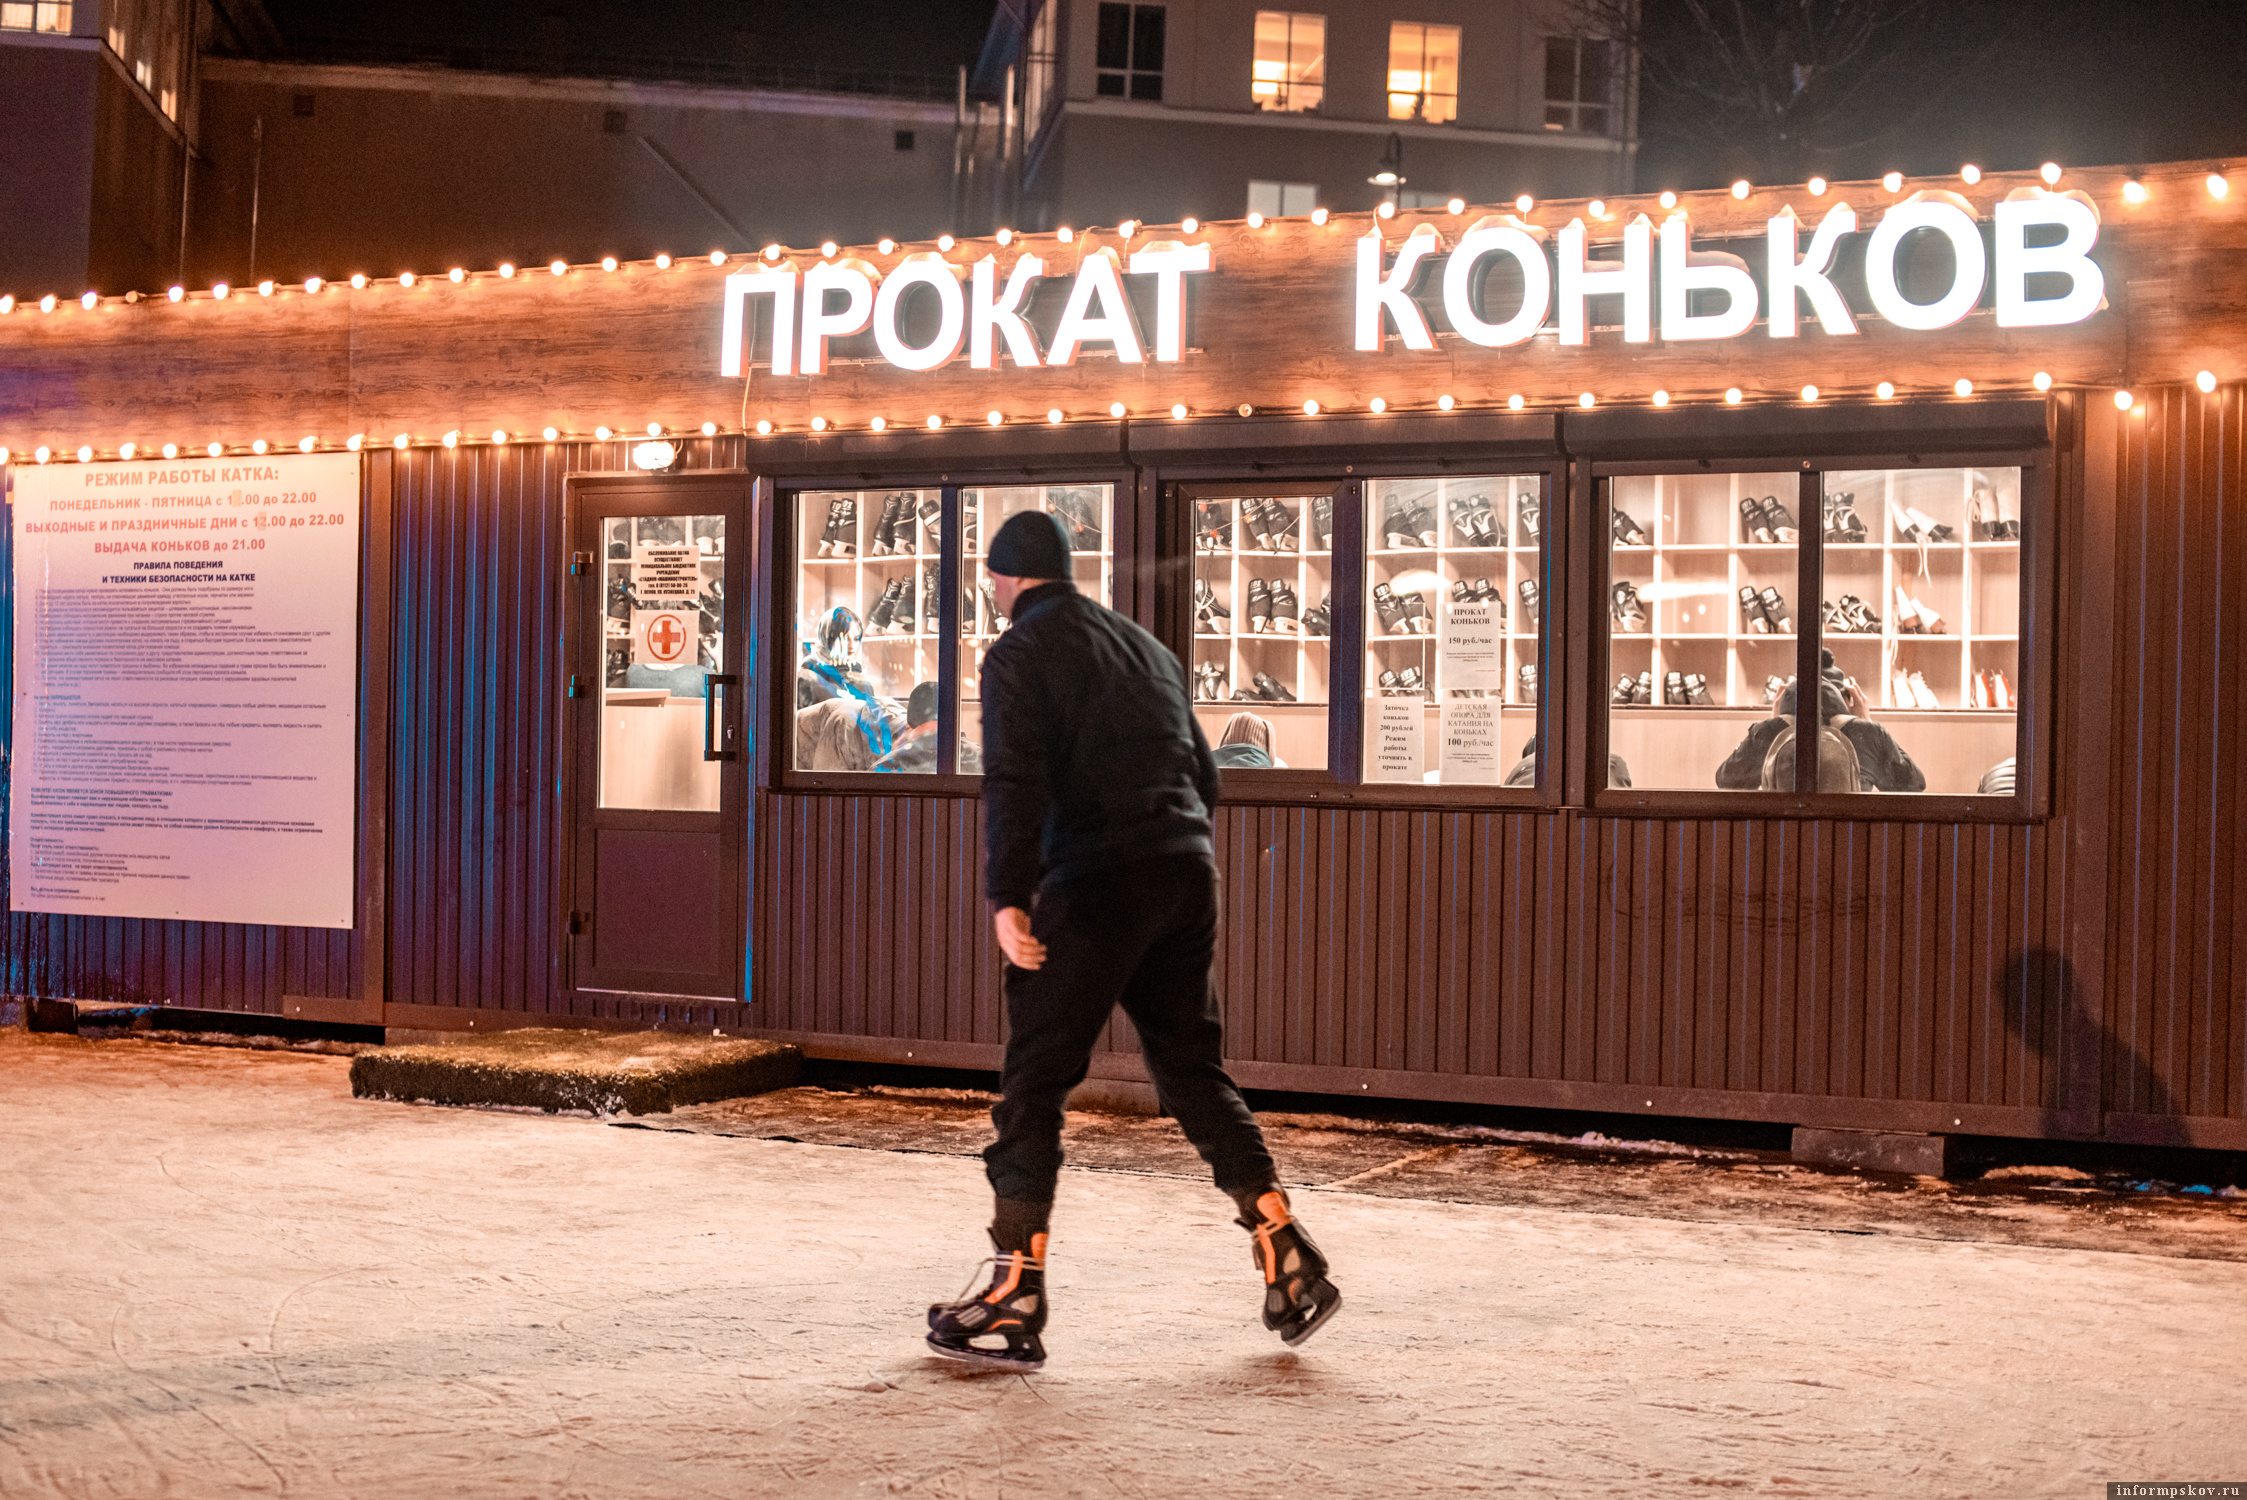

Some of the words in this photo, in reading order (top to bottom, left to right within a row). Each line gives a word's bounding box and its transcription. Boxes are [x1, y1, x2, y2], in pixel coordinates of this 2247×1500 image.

[720, 250, 1216, 377] ПРОКАТ
[1355, 200, 2104, 351] КОНЬКОВ
[85, 471, 142, 487] РЕЖИМ
[148, 468, 215, 484] РАБОТЫ
[221, 466, 279, 482] КАТКА:
[50, 498, 141, 512] ПОНЕДЕЛЬНИК
[152, 495, 212, 508] ПЯТНИЦА
[263, 496, 278, 506] до
[282, 492, 317, 504] 22.00
[25, 520, 95, 534] ВЫХОДНЫЕ
[99, 519, 108, 531] И
[111, 517, 207, 532] ПРАЗДНИЧНЫЕ
[210, 516, 237, 530] ДНИ
[240, 520, 248, 528] с
[289, 517, 305, 527] до
[309, 513, 344, 526] 22.00
[94, 541, 148, 554] ВЫДАЧА
[151, 539, 210, 552] КОНЬКОВ
[213, 543, 228, 552] до
[232, 538, 265, 550] 21.00
[133, 562, 171, 570] ПРАВИЛА
[173, 561, 223, 570] ПОВЕДЕНИЯ
[110, 575, 147, 583] ТЕХНИКИ
[148, 574, 213, 583] БЕЗОПАСНОСТИ
[216, 574, 227, 582] НА
[229, 573, 256, 581] КАТКЕ
[1454, 608, 1487, 616] ПРОКАТ
[1462, 636, 1492, 645] руб./час
[1448, 738, 1462, 746] 100
